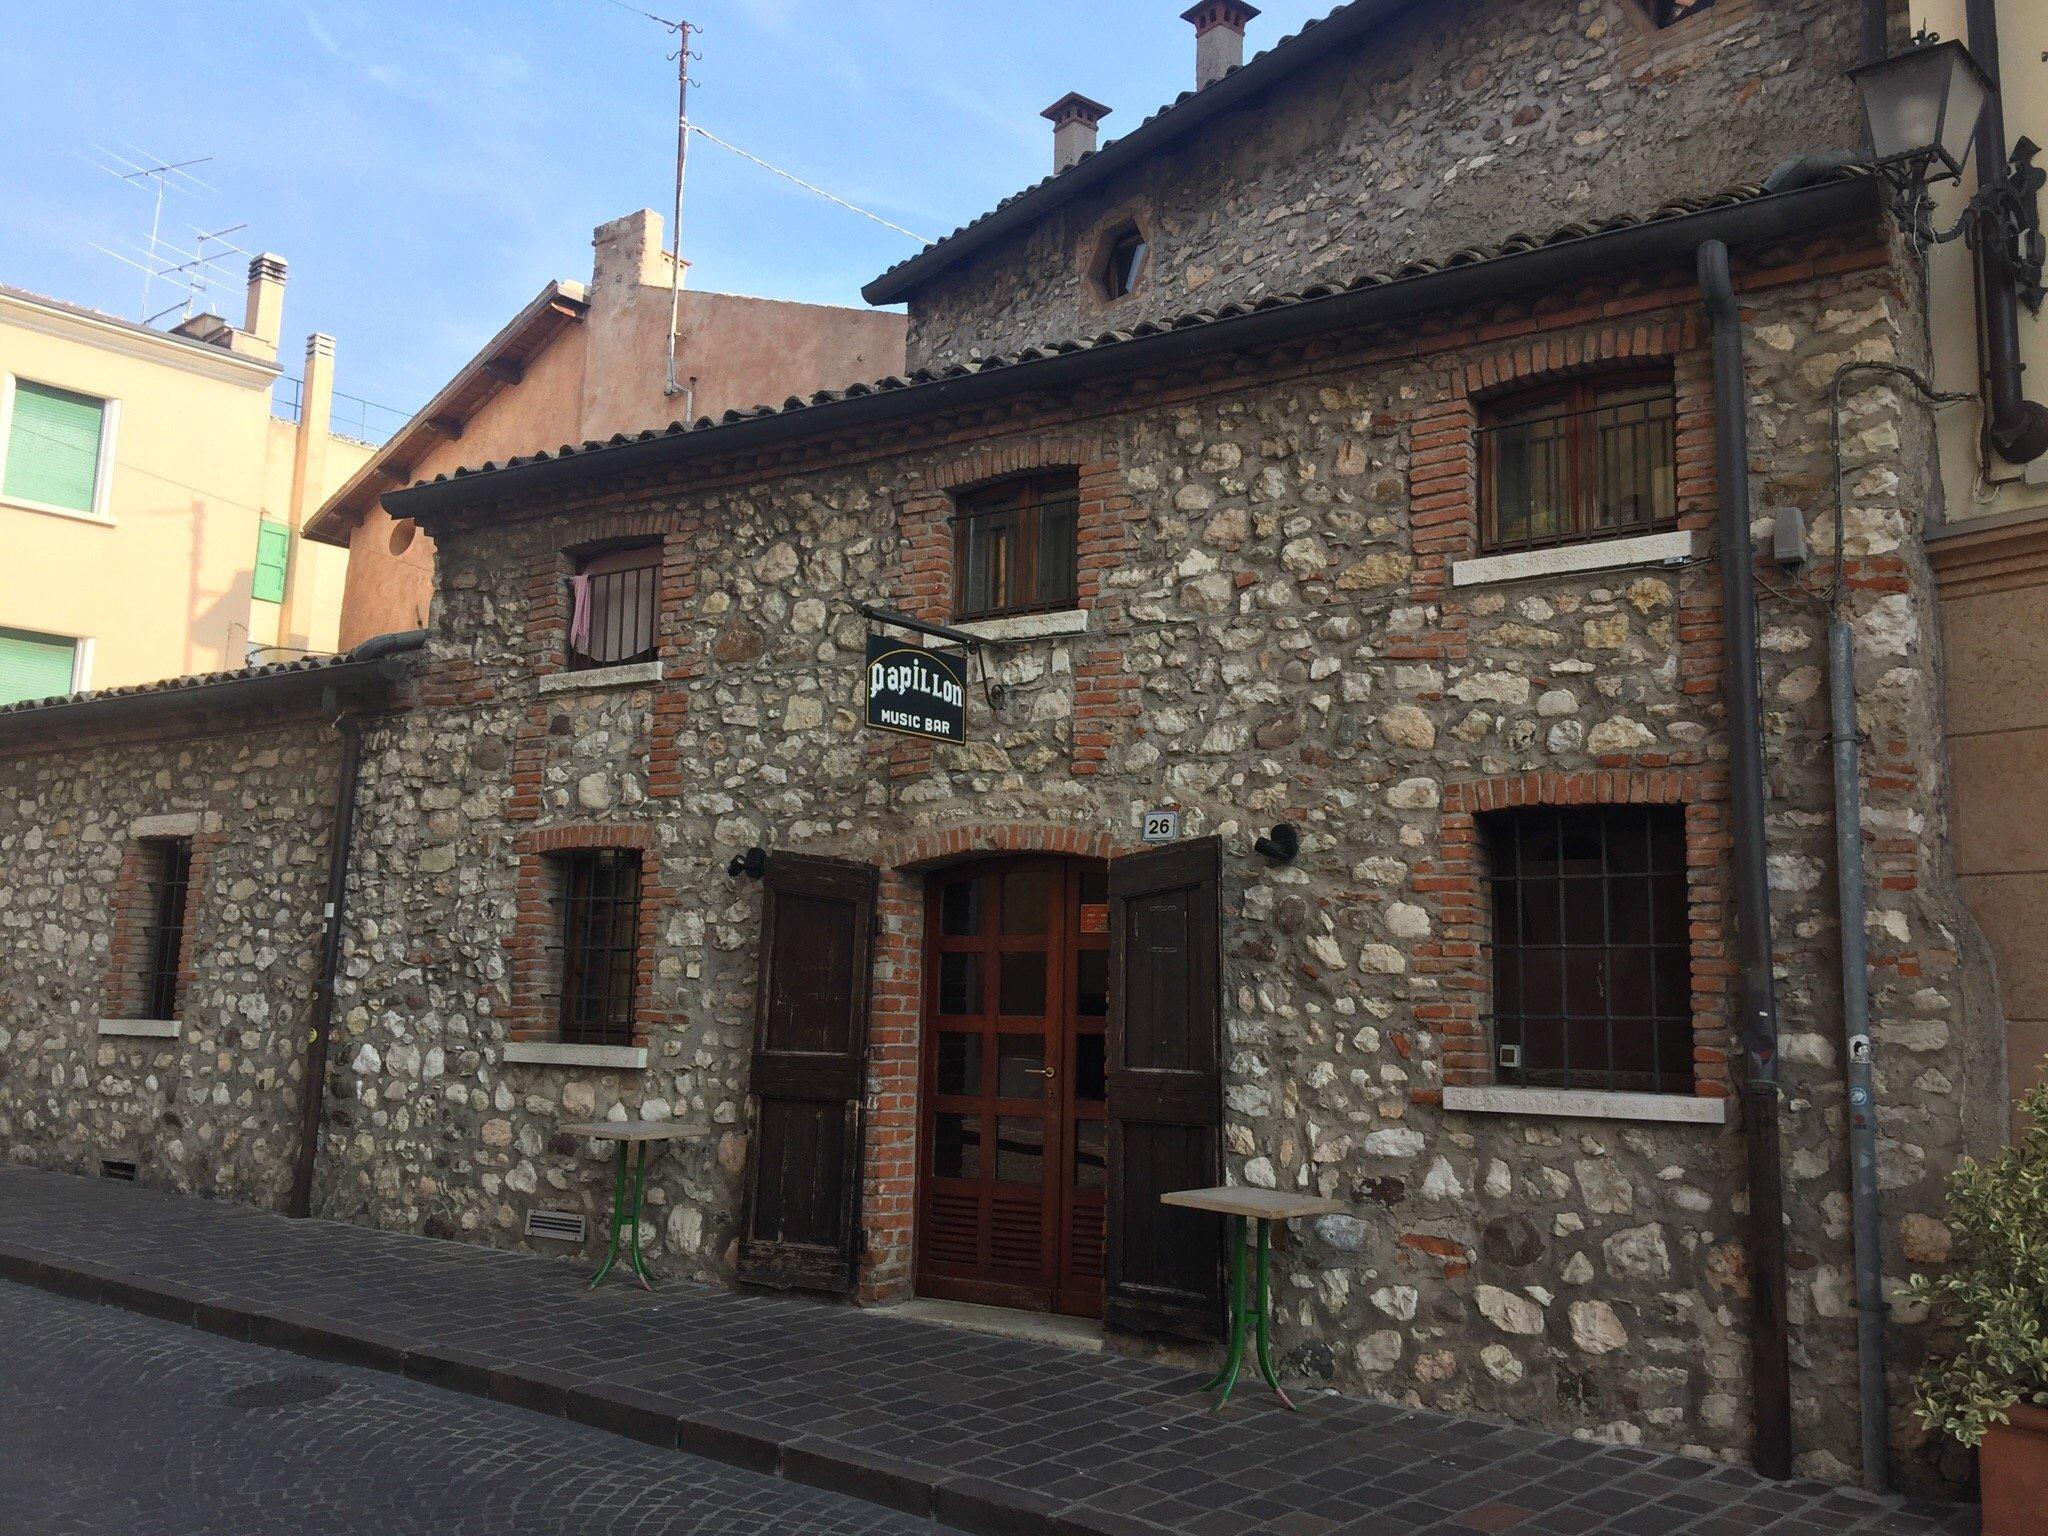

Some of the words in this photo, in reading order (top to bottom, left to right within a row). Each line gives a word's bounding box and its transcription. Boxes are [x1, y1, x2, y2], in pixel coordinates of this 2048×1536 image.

[881, 709, 921, 729] MUSIC
[924, 717, 951, 734] BAR
[1148, 818, 1170, 835] 26
